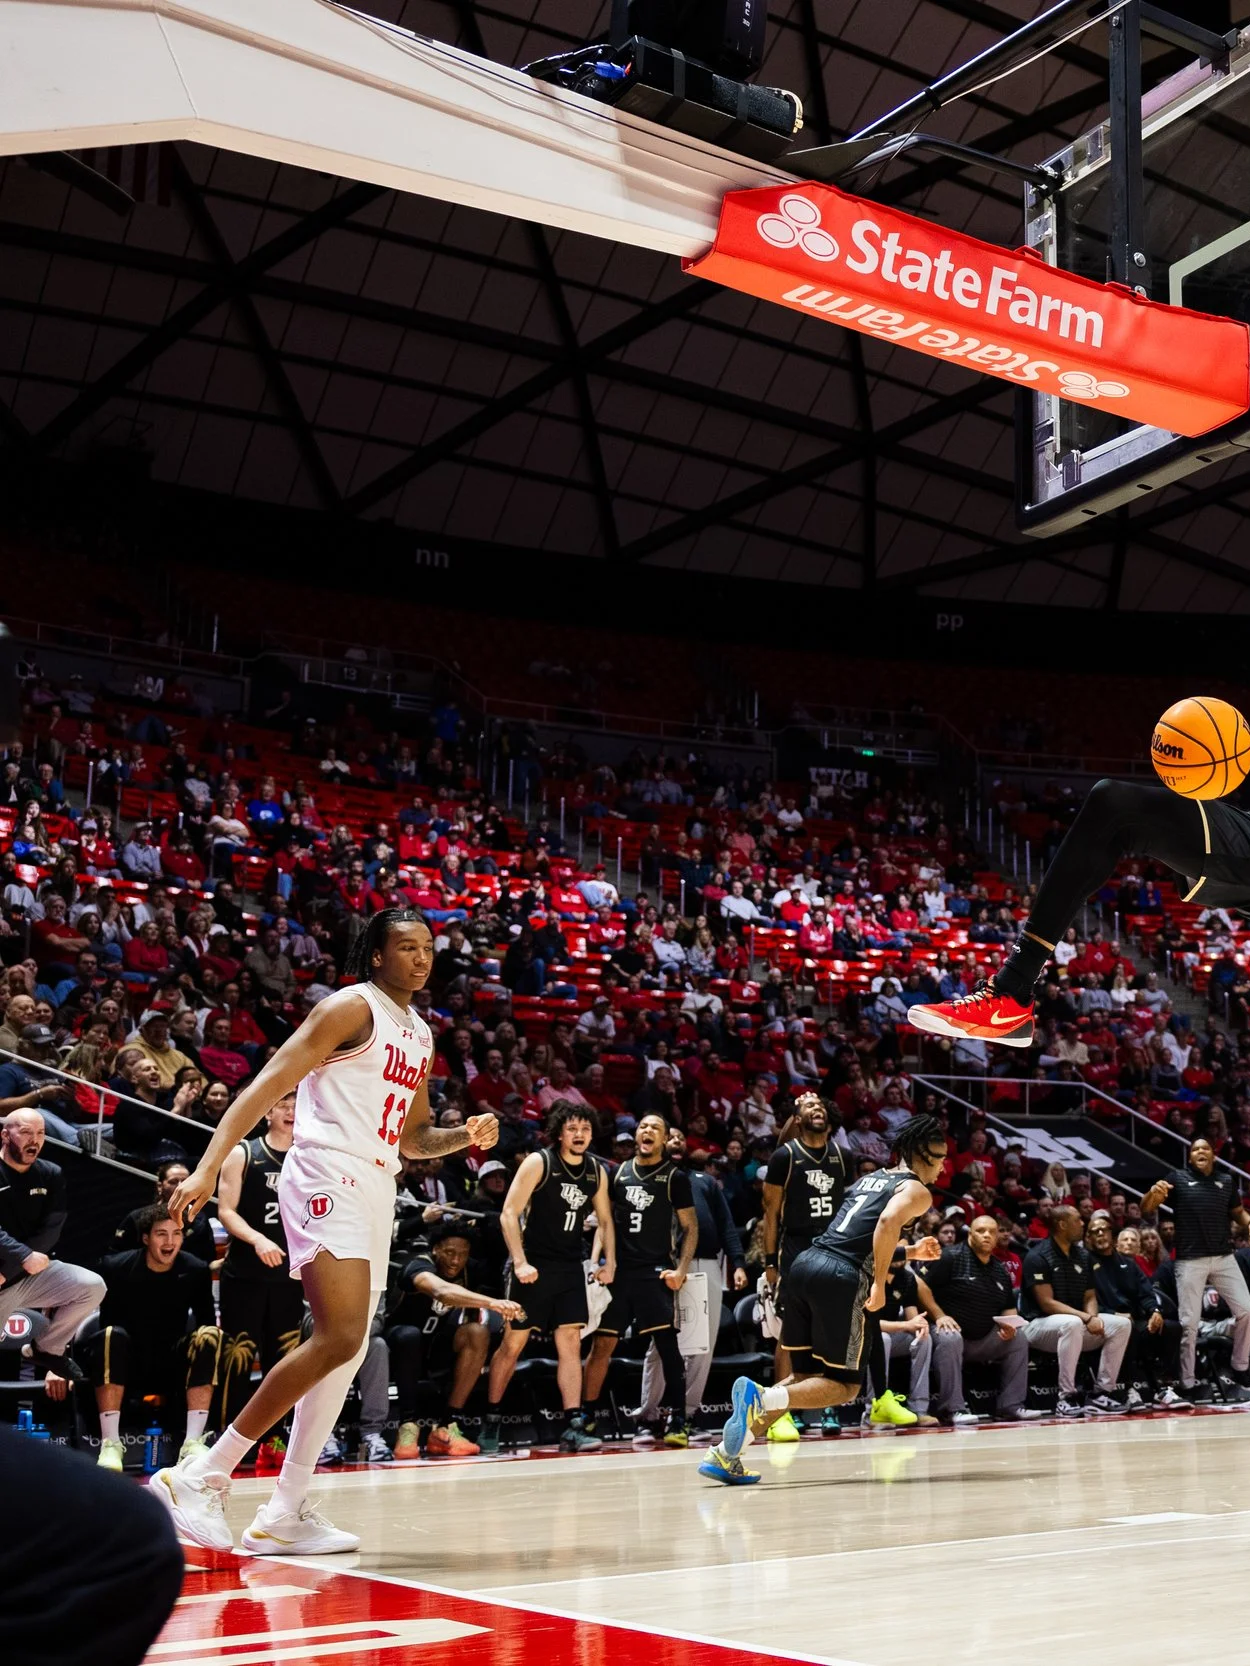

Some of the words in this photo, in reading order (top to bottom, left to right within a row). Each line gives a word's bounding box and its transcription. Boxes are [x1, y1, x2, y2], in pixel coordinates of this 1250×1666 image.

[416, 548, 450, 569] nn
[936, 611, 964, 632] pp
[383, 1043, 428, 1091] Utah
[378, 1093, 406, 1146] 13
[805, 1169, 835, 1195] UCF
[560, 1182, 588, 1210] UCF
[625, 1185, 655, 1211] UCF
[311, 1198, 328, 1217] U
[809, 1196, 833, 1218] 35
[836, 1195, 868, 1232] 1
[563, 1211, 577, 1232] 11
[629, 1212, 643, 1233] 3
[8, 1319, 25, 1334] U
[422, 1316, 439, 1334] 0
[700, 1401, 734, 1414] bamb
